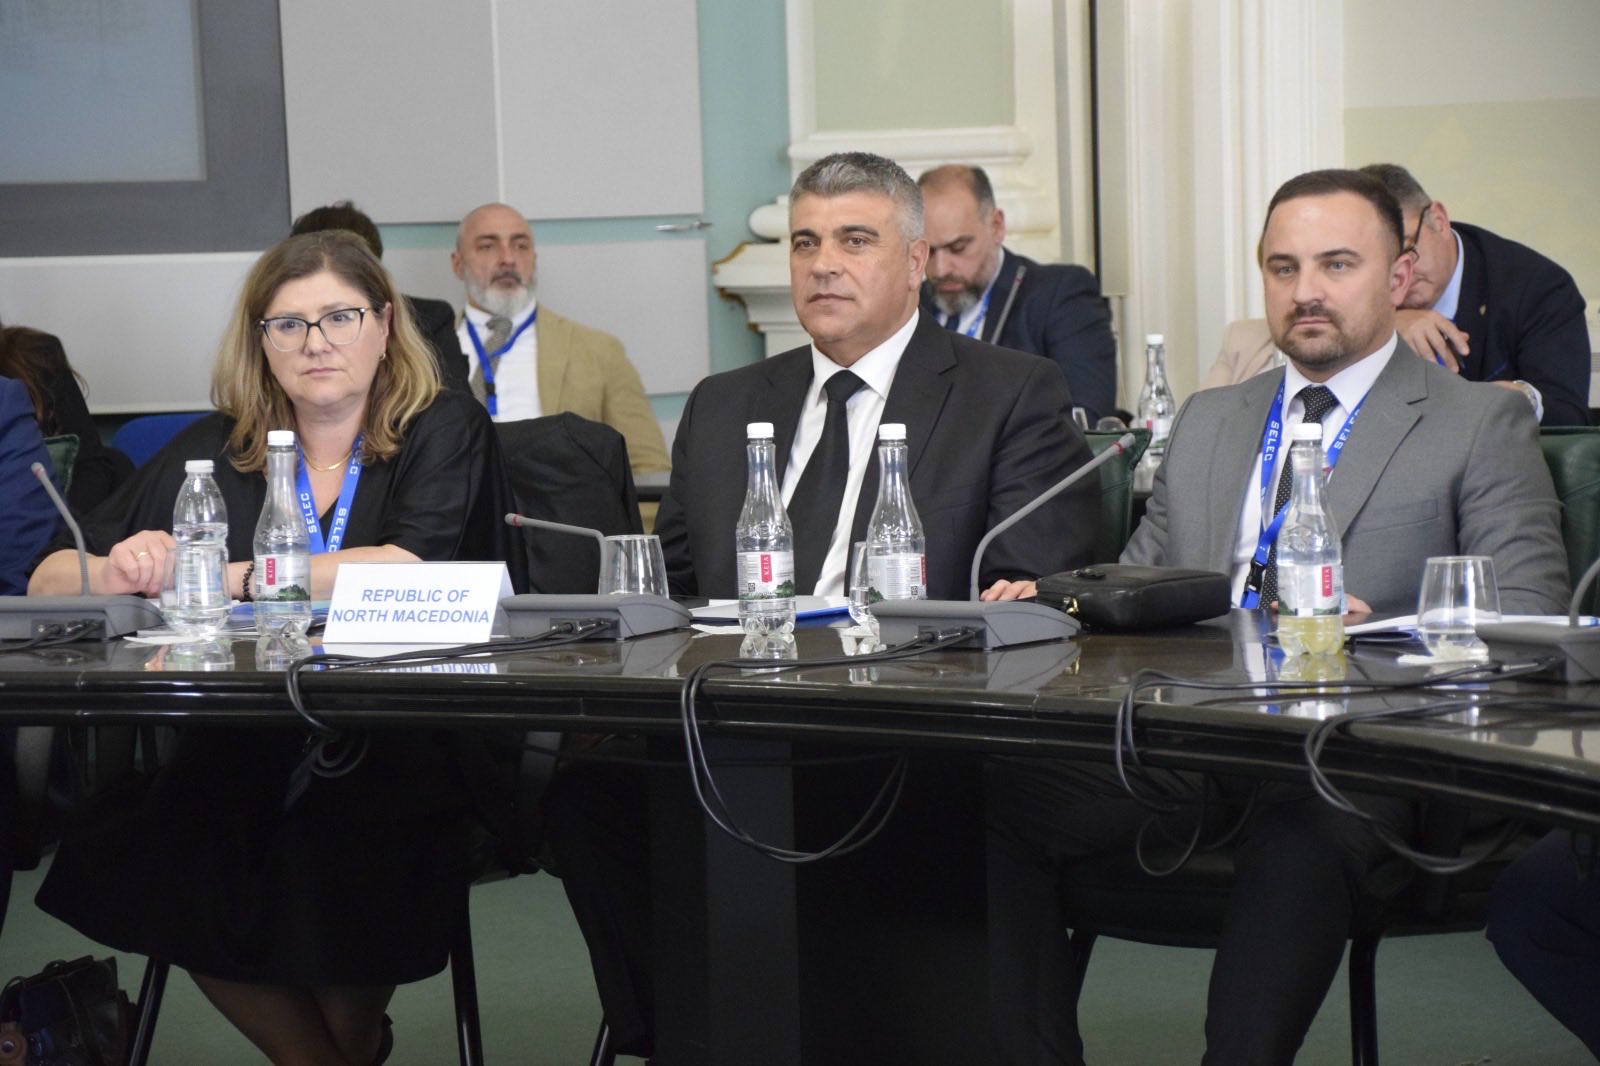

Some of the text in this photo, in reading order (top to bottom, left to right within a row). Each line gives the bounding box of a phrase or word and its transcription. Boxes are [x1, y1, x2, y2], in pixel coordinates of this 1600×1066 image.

[1264, 420, 1280, 461] SELEC
[300, 492, 318, 534] SELEC
[328, 507, 347, 553] SELEC
[332, 609, 489, 623] NORTH MACEDONIA
[362, 589, 470, 602] REPUBLIC OF
